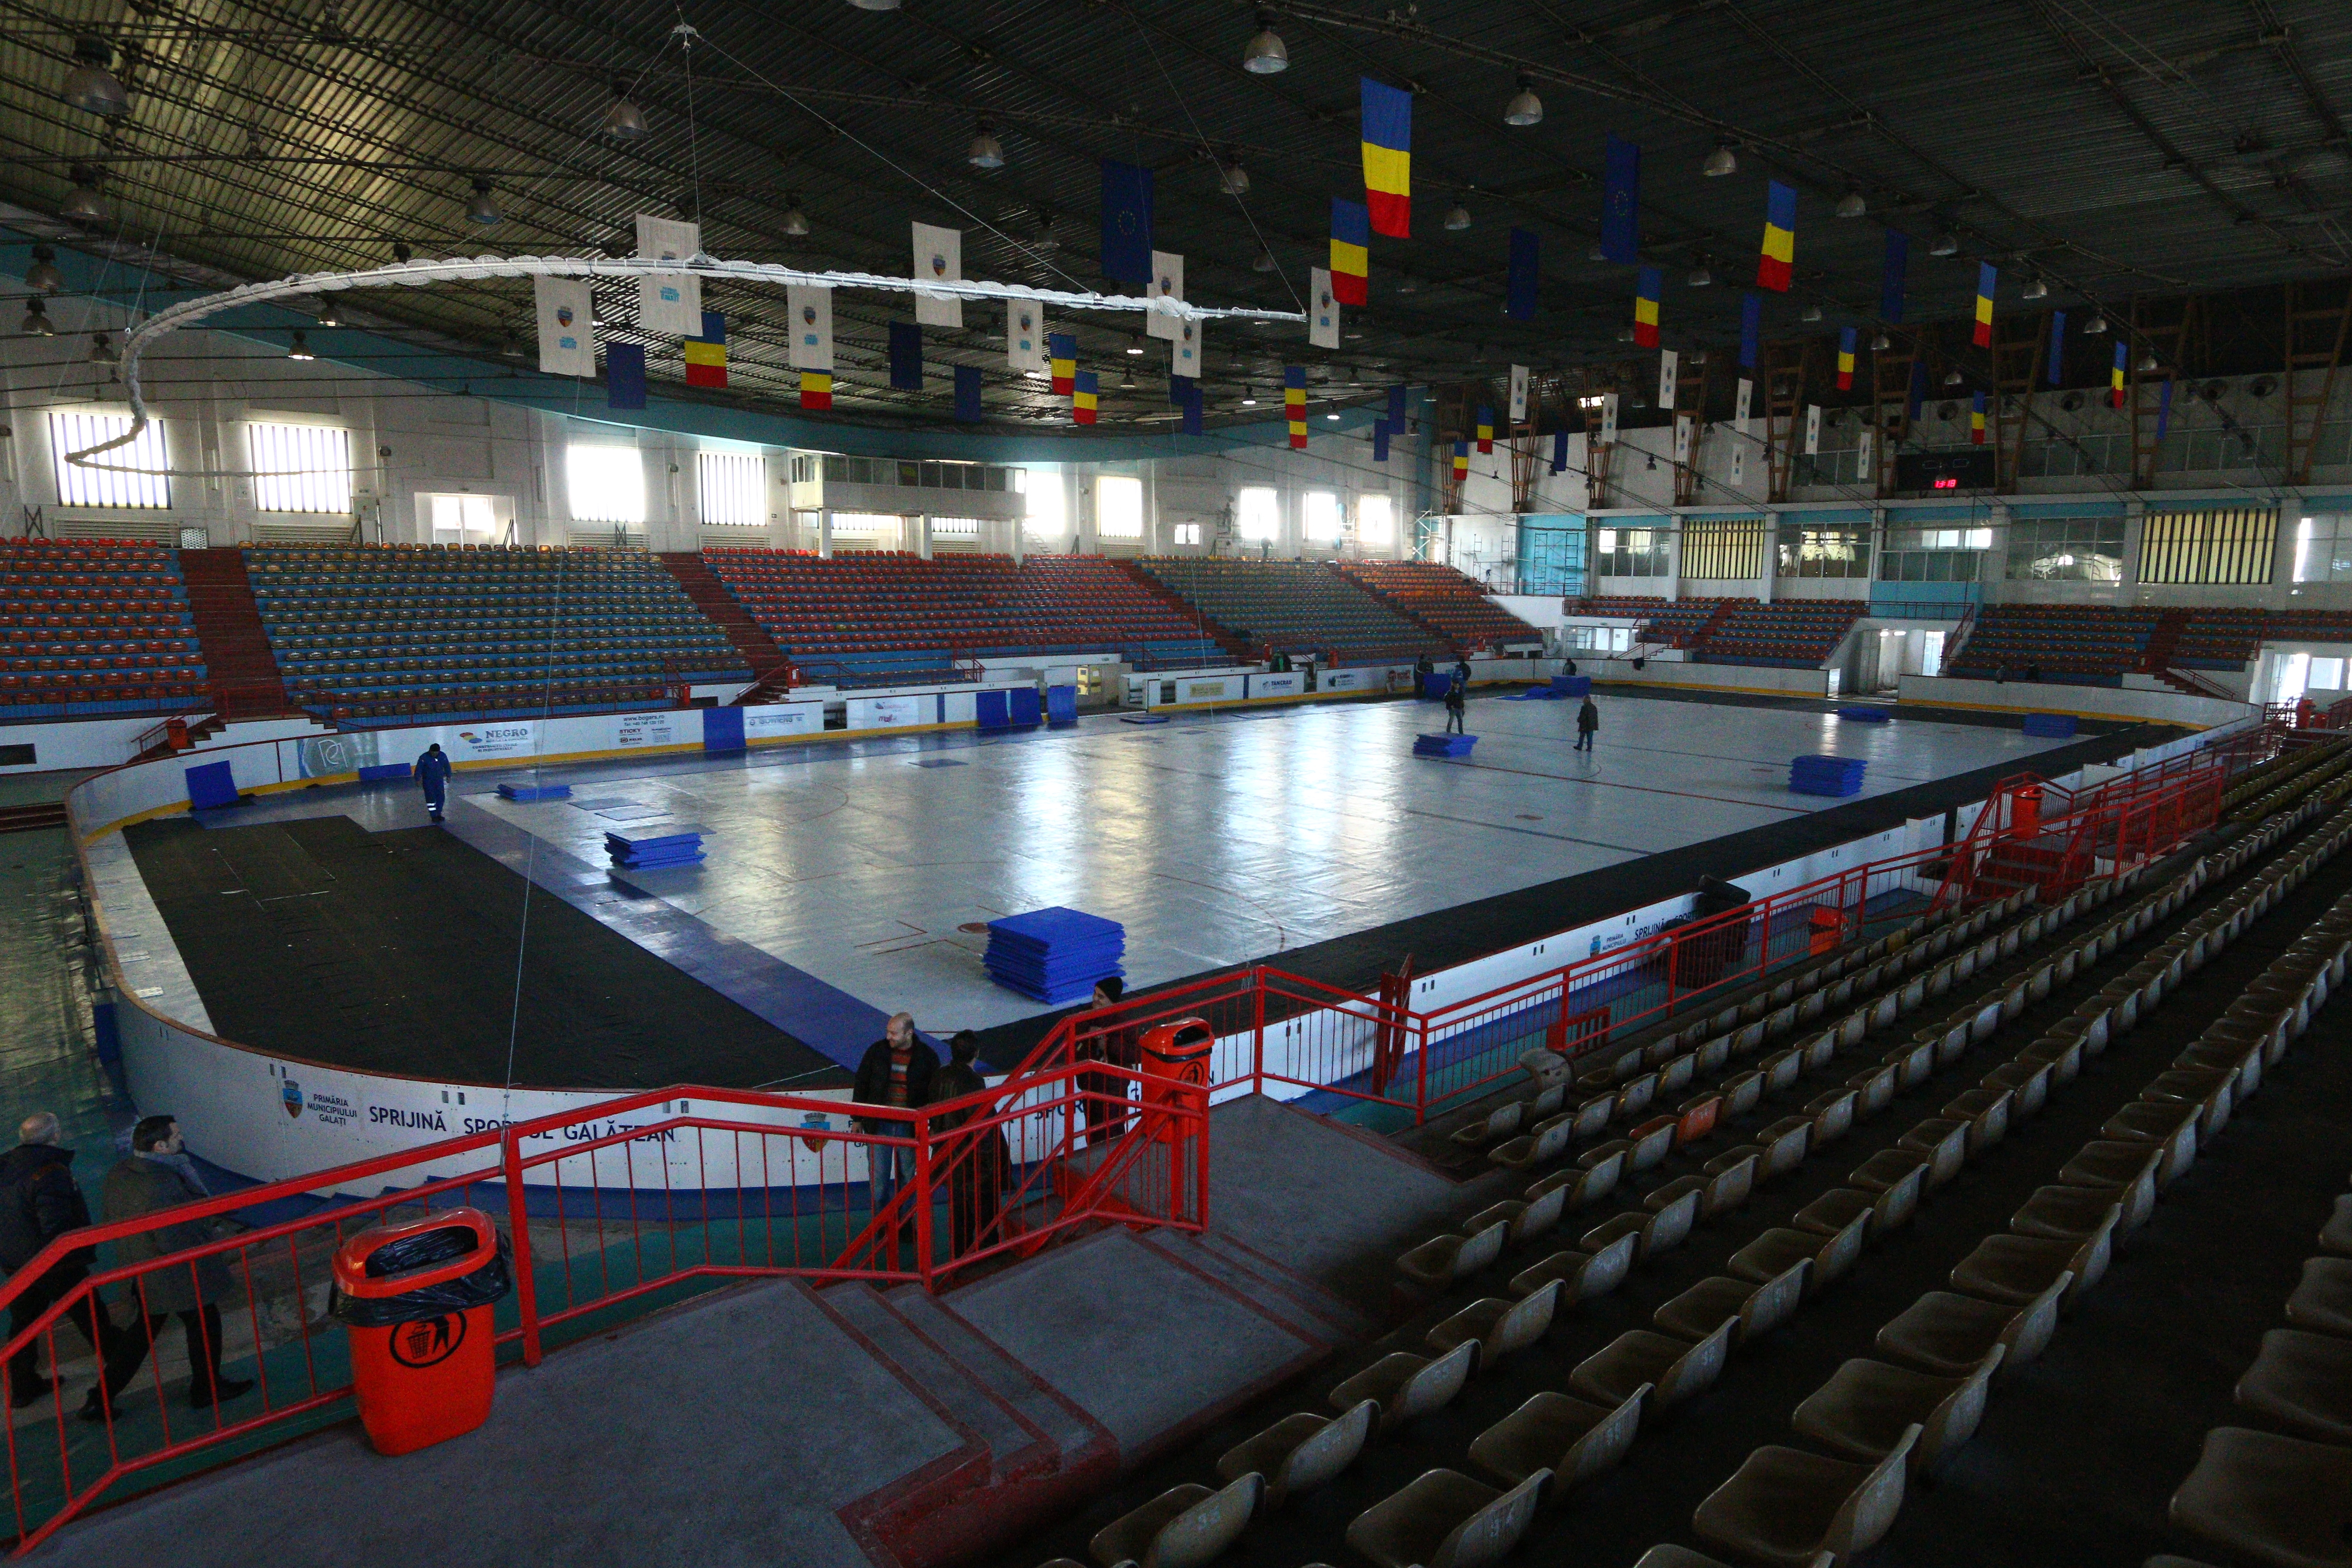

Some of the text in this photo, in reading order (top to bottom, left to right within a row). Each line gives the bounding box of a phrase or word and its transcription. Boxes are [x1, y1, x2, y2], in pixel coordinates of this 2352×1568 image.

[486, 729, 528, 738] NEGRO
[314, 1094, 349, 1107] PRIMĂRIA
[308, 1102, 357, 1118] MUNICIPIULUI
[369, 1106, 447, 1132] SPRIJINĂ
